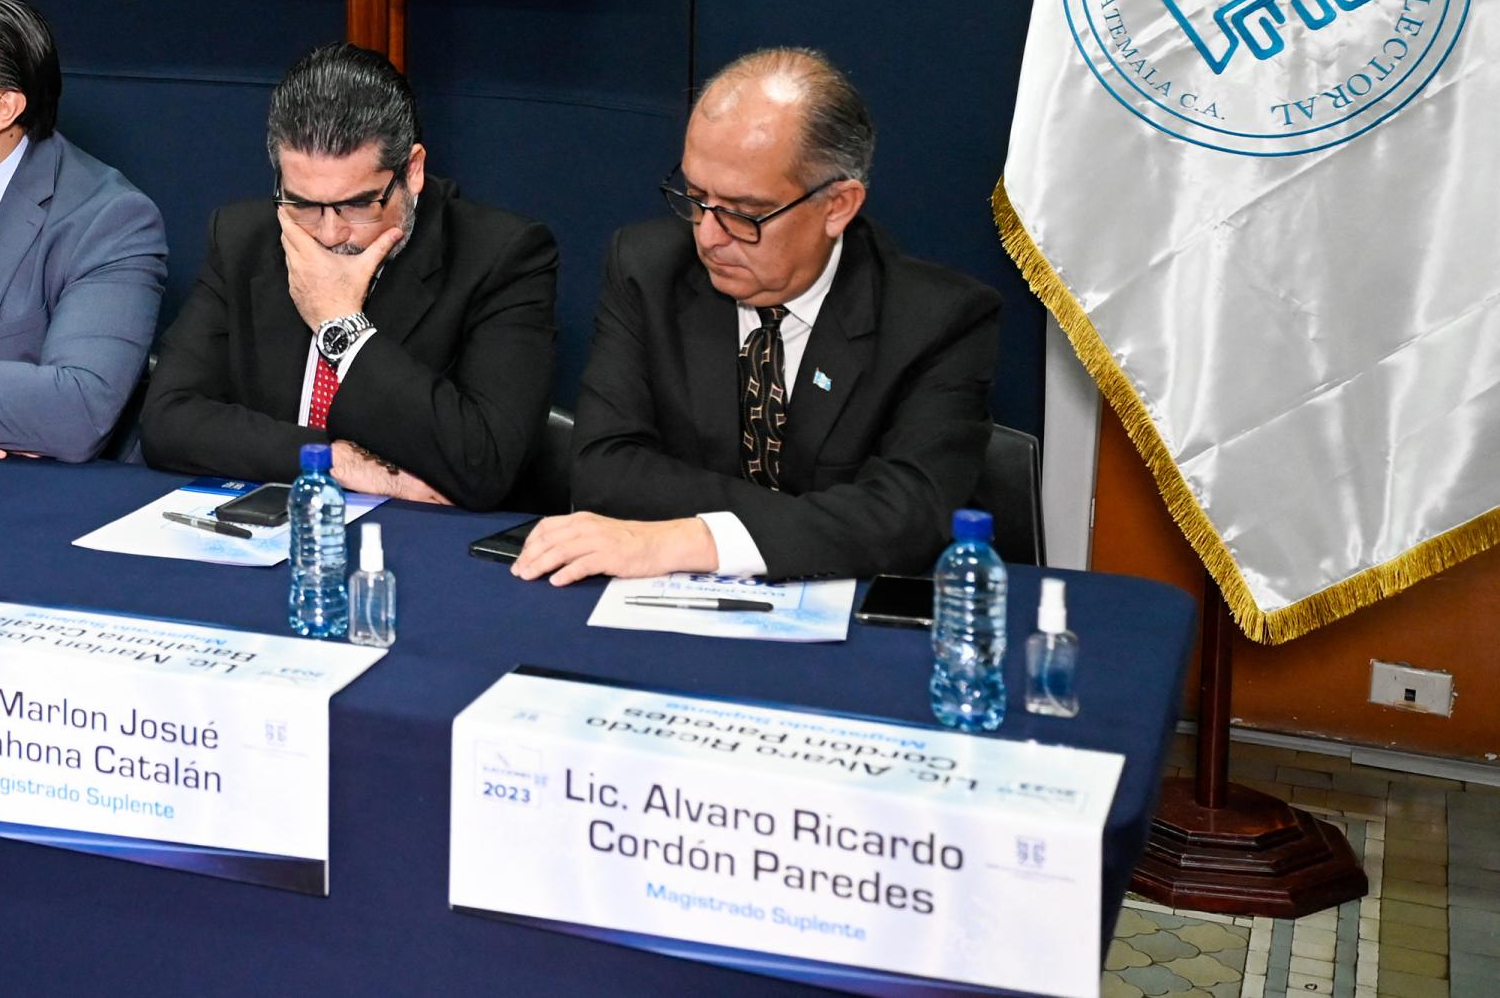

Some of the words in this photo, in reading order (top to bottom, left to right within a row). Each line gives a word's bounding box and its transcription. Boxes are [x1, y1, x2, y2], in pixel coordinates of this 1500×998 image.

[1180, 93, 1227, 120] C.A.
[52, 639, 170, 665] Marlon
[95, 630, 258, 663] Barahona
[121, 709, 220, 751] Josué
[584, 715, 739, 753] Ricardo
[619, 706, 789, 746] Paredes
[95, 746, 222, 794] Catalán
[753, 743, 896, 778] Alvaro
[86, 787, 175, 819] Suplente
[482, 781, 533, 804] 2023
[565, 768, 629, 812] Lic.
[643, 784, 775, 838] Alvaro
[792, 811, 966, 873] Ricardo
[588, 820, 736, 877] Cordón
[753, 852, 936, 915] Paredes
[645, 881, 767, 922] Magistrado
[772, 906, 867, 943] Suplente
